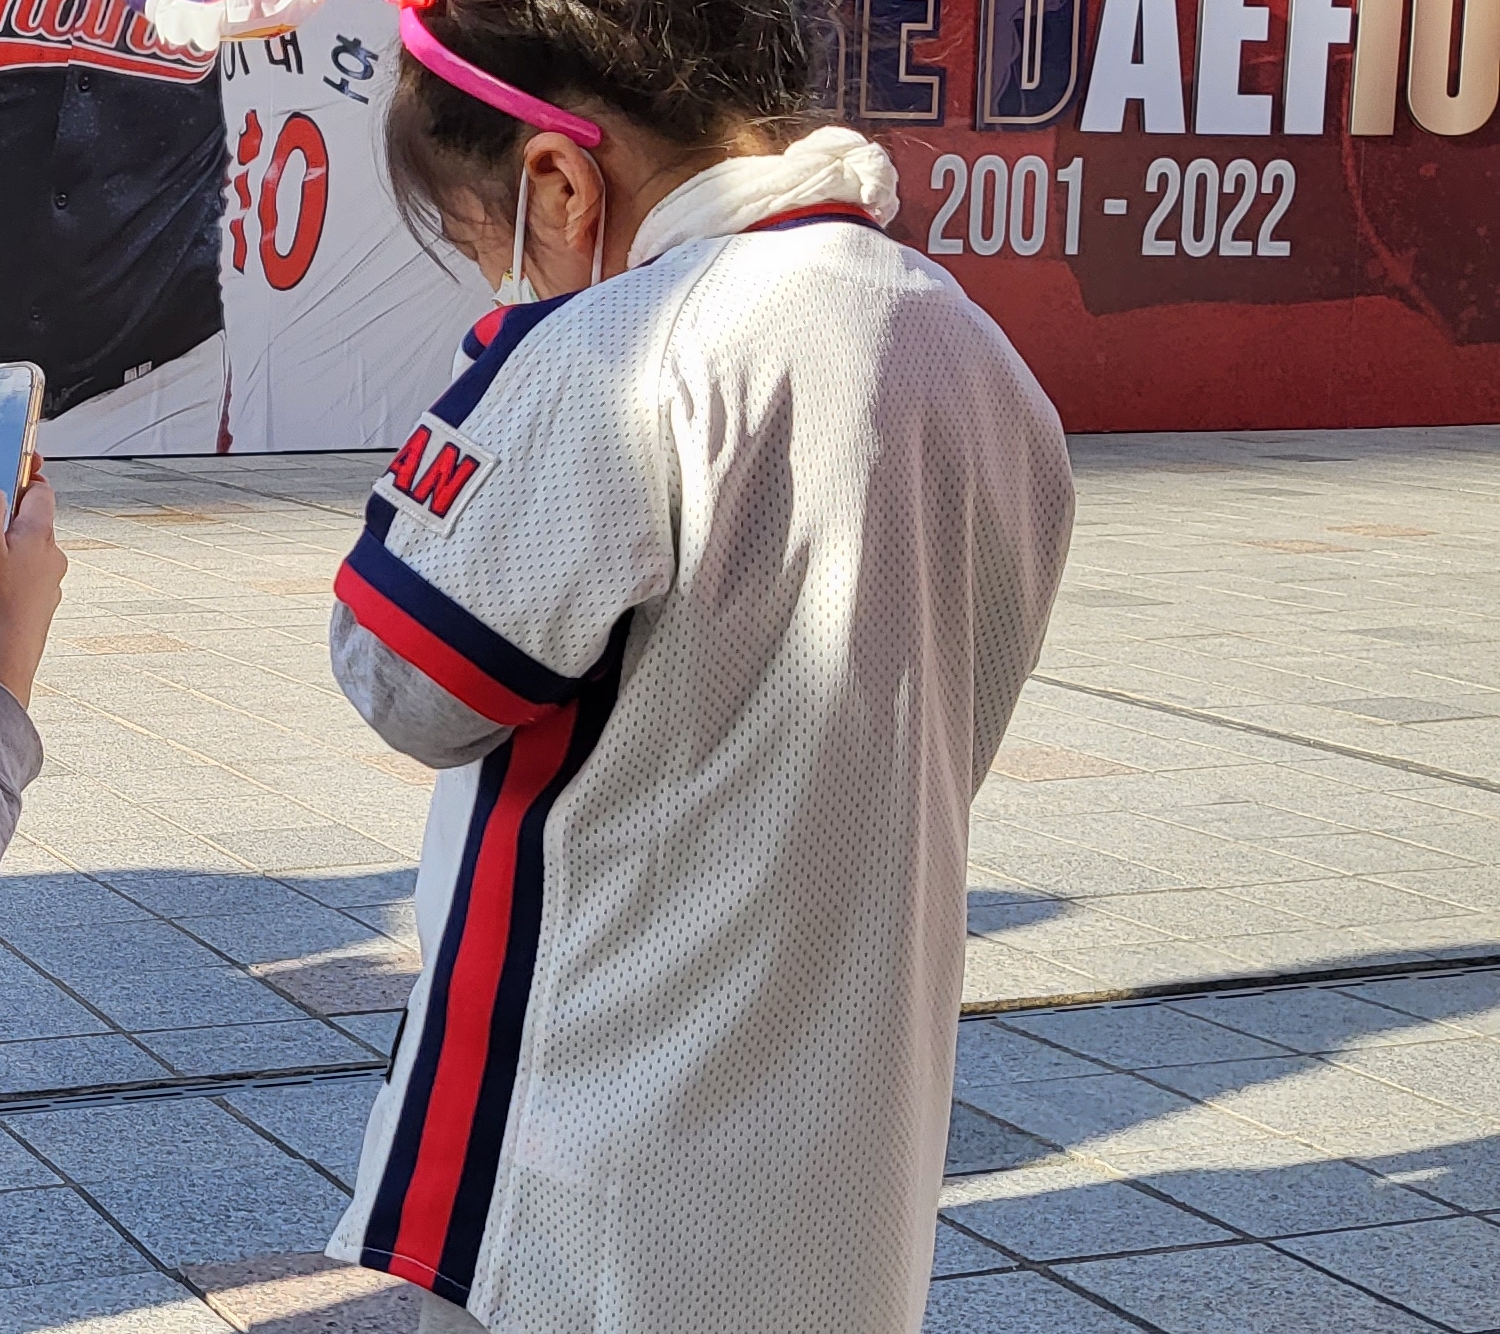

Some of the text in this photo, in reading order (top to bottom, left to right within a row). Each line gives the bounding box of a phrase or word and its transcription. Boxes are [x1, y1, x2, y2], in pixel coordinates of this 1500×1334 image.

[229, 109, 329, 292] 10
[927, 153, 1084, 256] 2001
[1141, 157, 1296, 259] 2022
